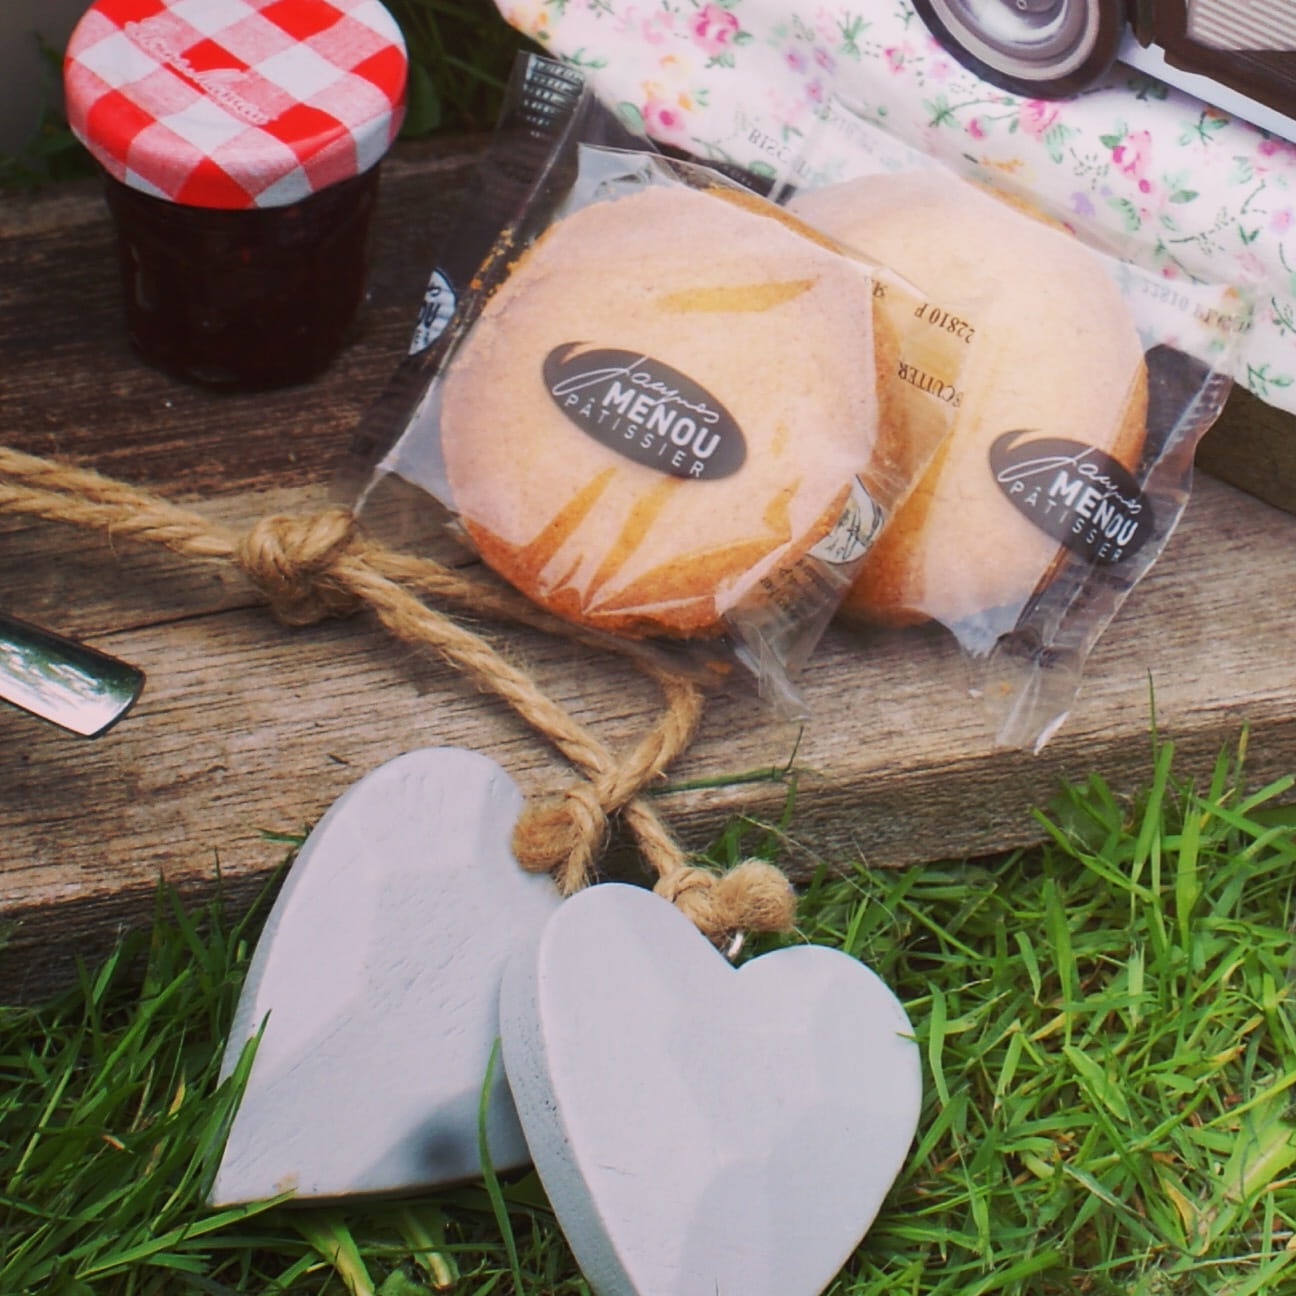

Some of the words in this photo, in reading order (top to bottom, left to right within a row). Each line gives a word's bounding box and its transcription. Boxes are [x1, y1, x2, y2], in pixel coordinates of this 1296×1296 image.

[564, 393, 705, 479] PÂTISSIER
[602, 380, 721, 460] MENOU
[1009, 480, 1123, 562] PÂTISSER
[1049, 469, 1139, 547] MENOU
